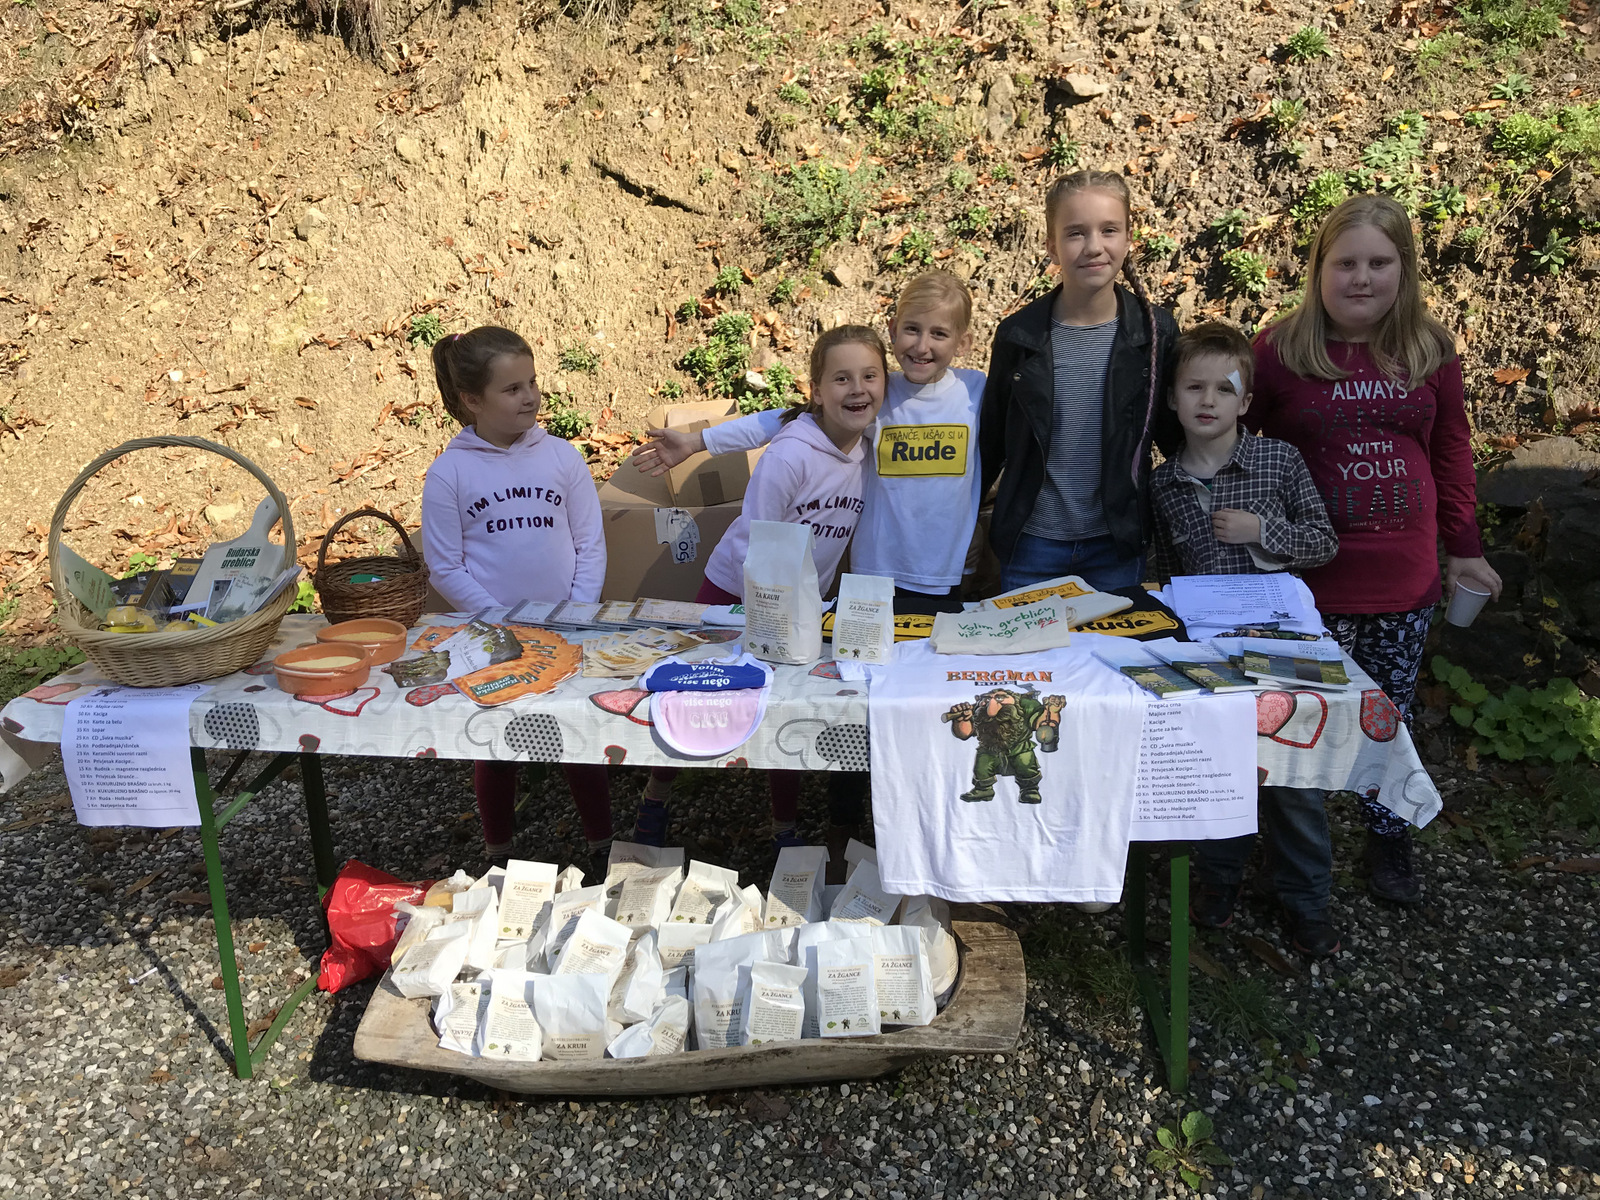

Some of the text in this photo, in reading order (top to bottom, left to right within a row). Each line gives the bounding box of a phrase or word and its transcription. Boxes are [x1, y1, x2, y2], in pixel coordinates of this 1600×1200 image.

[1331, 380, 1408, 400] ALWAYS
[884, 428, 964, 442] STRANČE, UŠAO SI U
[891, 440, 957, 461] Rude
[1347, 440, 1393, 455] WITH
[1336, 459, 1408, 480] YOUR
[466, 486, 562, 518] I'M LIMITED
[1321, 480, 1422, 519] HEART
[796, 499, 820, 515] I'M
[486, 515, 554, 534] EDITION
[226, 546, 261, 558] Rudarska
[221, 558, 256, 569] greblica
[755, 591, 780, 601] ZA KRUH
[857, 605, 879, 613] ŽGANCE
[958, 606, 1052, 630] Volim greblicu
[958, 626, 1019, 638] više nego
[691, 665, 725, 673] Volim
[945, 670, 1054, 682] BERGMAN
[702, 678, 730, 687] nego
[683, 697, 732, 708] više nego
[836, 971, 861, 979] ŽGANCE
[770, 991, 793, 999] ŽGANCE
[726, 1008, 741, 1016] KRU
